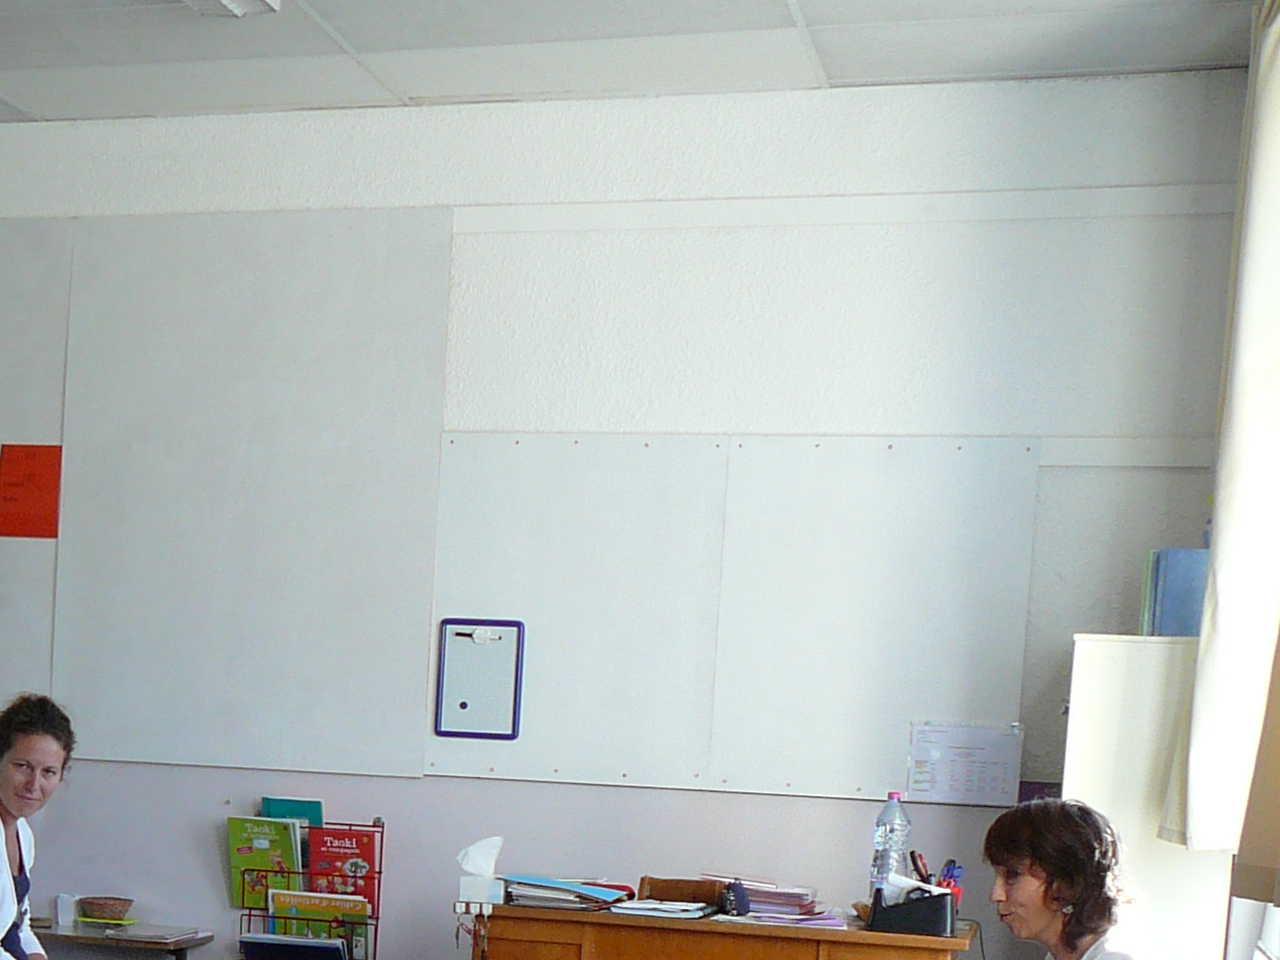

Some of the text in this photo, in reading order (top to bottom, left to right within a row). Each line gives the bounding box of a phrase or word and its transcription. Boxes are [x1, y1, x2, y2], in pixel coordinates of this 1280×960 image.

[244, 823, 275, 834] Taoki
[323, 836, 357, 848] Taoki
[279, 895, 362, 911] Cahier d'activités
